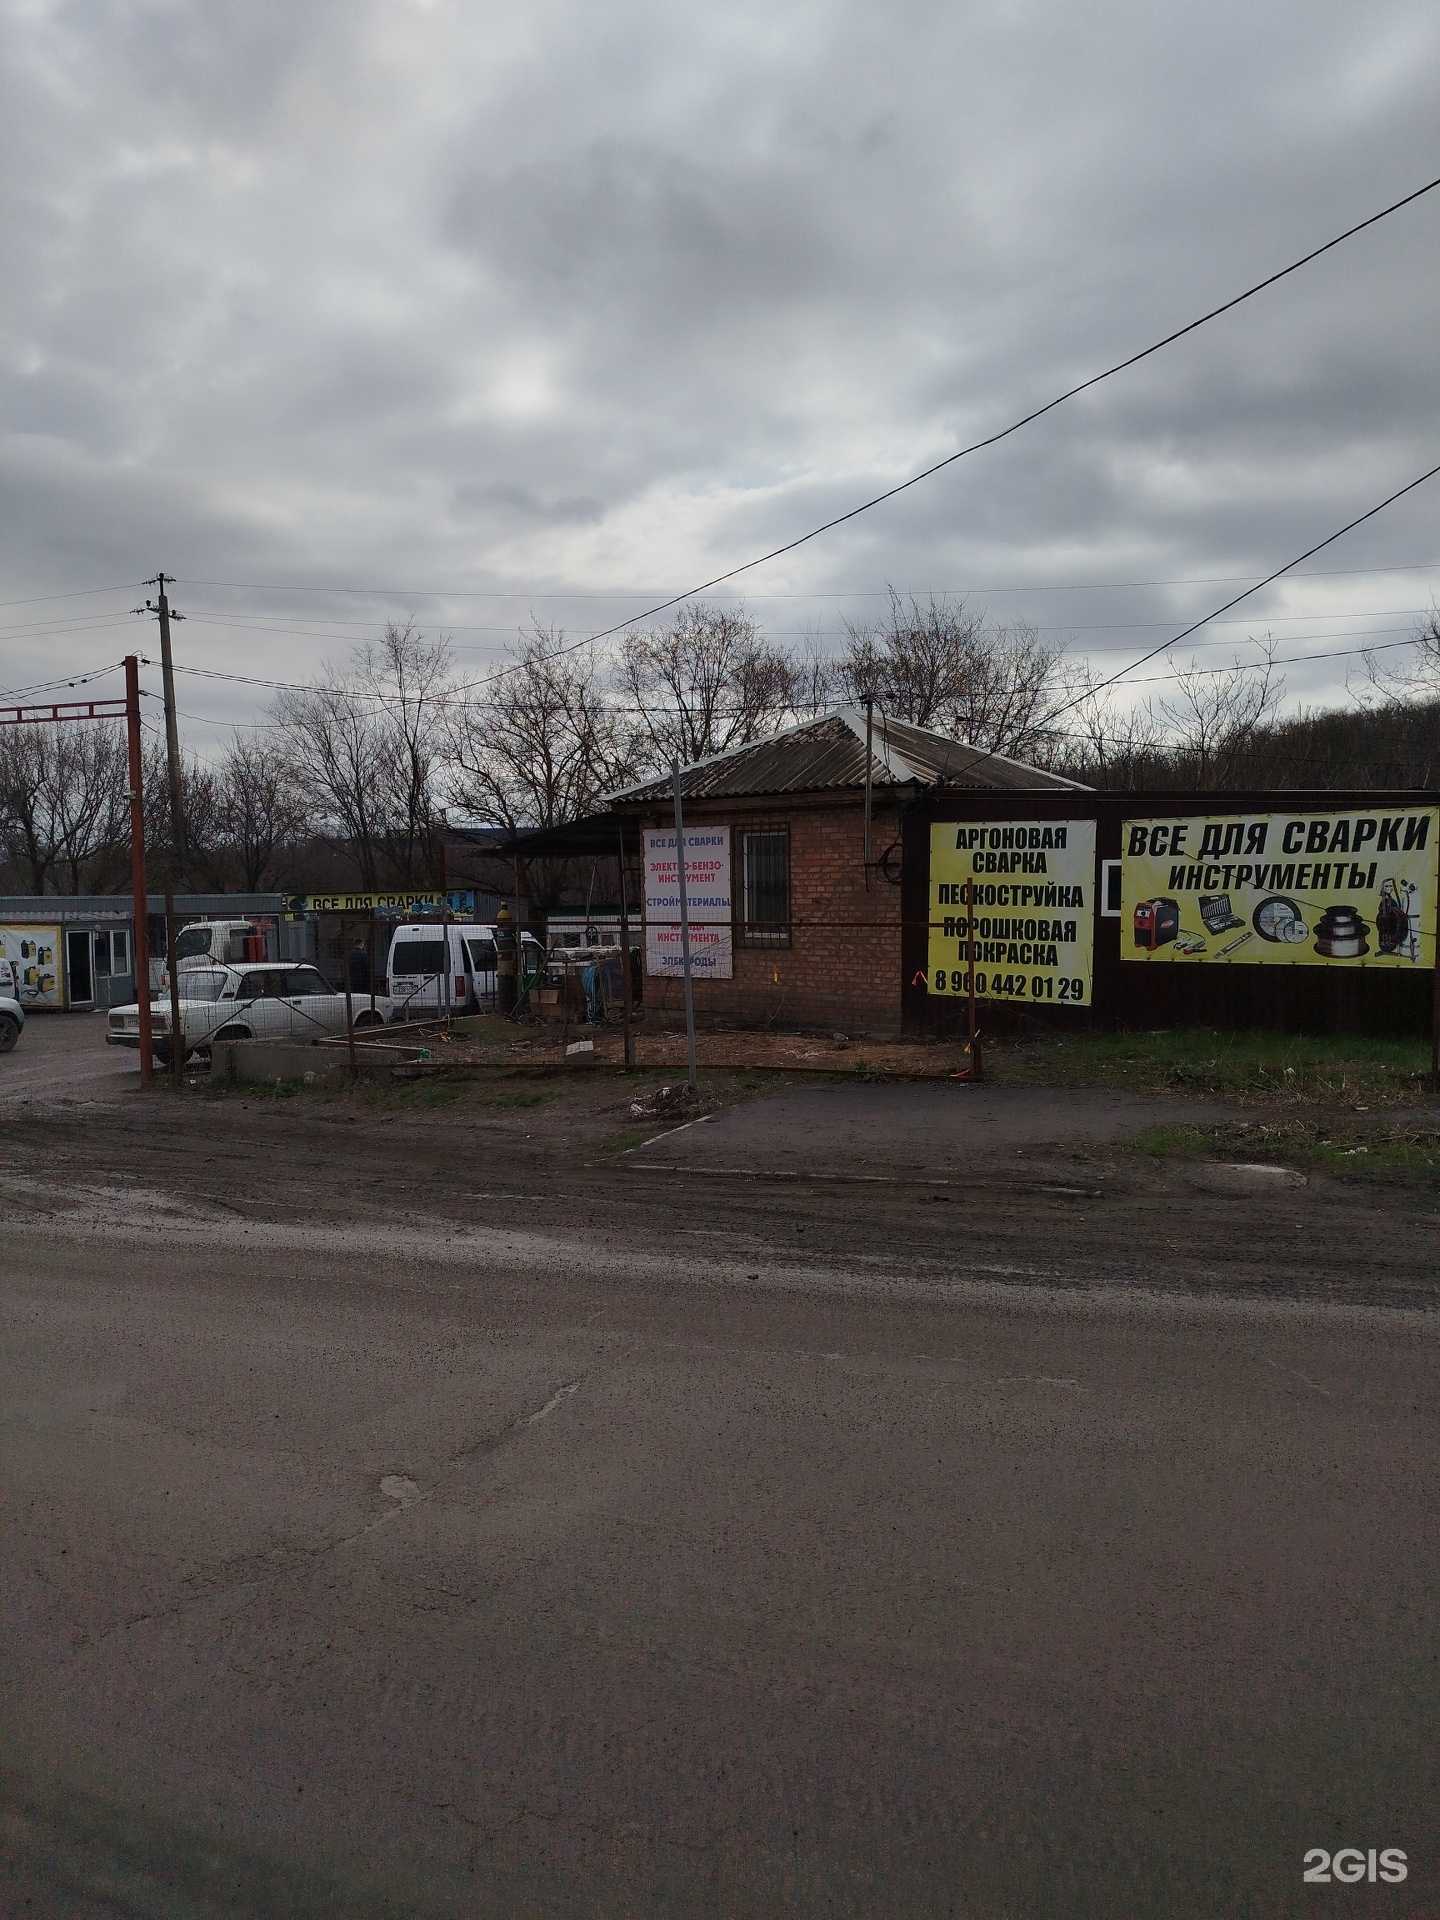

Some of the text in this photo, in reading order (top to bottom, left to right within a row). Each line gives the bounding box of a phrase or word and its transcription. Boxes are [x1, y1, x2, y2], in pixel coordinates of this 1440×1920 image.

[650, 839, 667, 848] ВСЕ
[688, 836, 723, 847] СВАРКИ
[956, 827, 1067, 849] АРГОНОВАЯ
[1127, 816, 1431, 860] ВСЕ ДЛЯ СВАРКИ
[972, 852, 1047, 873] СВАРКА
[658, 873, 715, 883] ИНСТУМЕНТ
[1168, 862, 1378, 890] ИНСТРУМЕНТЫ
[647, 896, 731, 907] СТРОЙМТЕРИАЛЫ
[938, 881, 1084, 907] ПЕСКОСТРУЙКА
[935, 970, 946, 990] 8
[992, 973, 1027, 996] 442
[1031, 976, 1053, 998] 01
[1058, 977, 1084, 1000] 29
